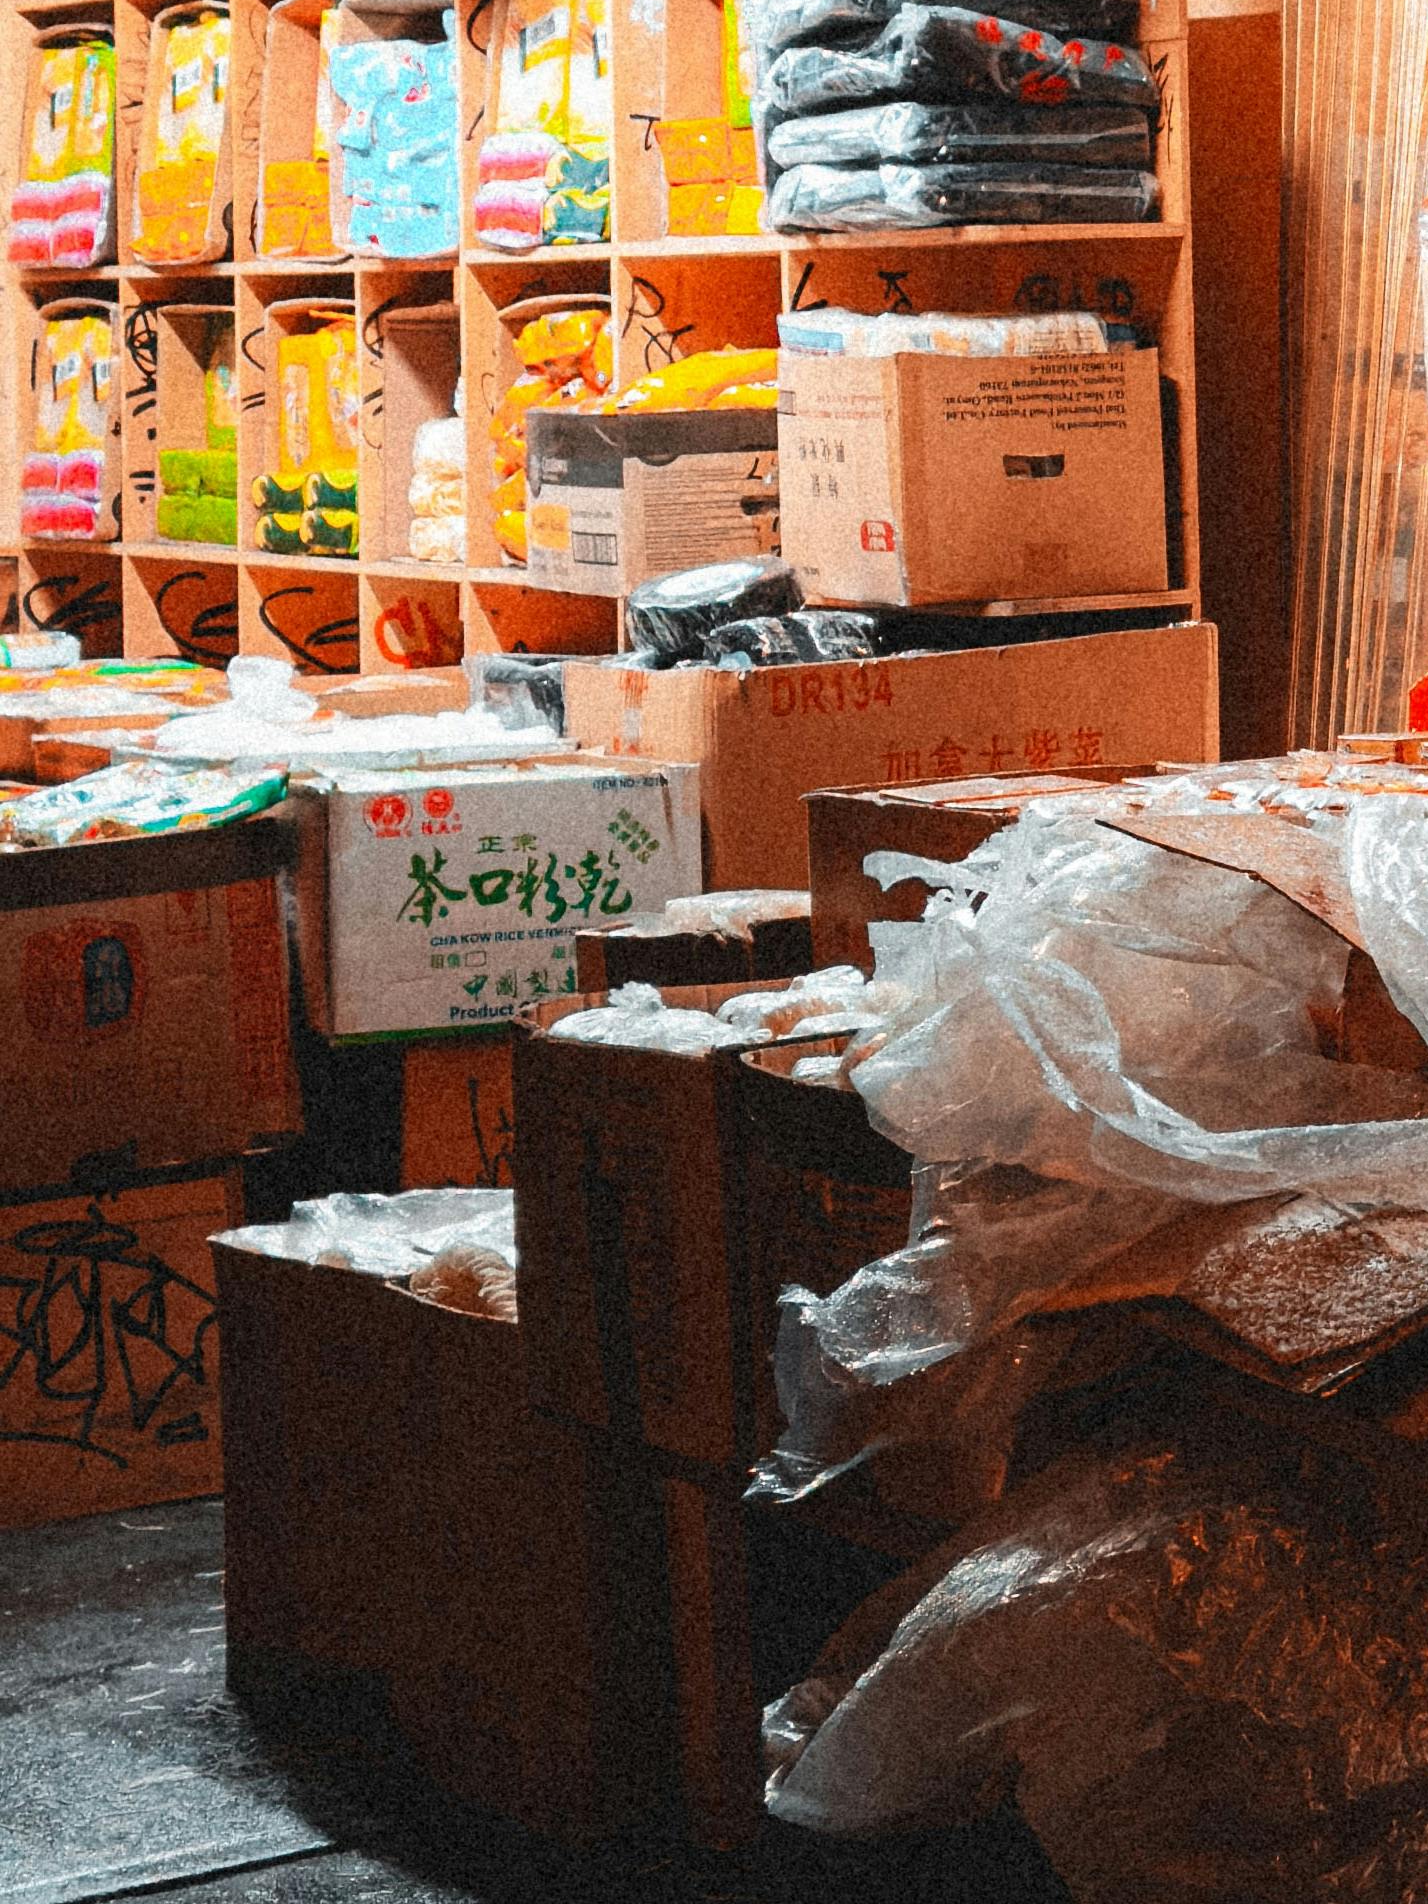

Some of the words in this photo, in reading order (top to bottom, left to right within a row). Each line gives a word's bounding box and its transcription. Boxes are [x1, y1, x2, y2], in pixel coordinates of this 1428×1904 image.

[770, 664, 896, 718] DR134
[396, 844, 634, 928] 茶口粉乾
[430, 936, 458, 948] CHA
[460, 933, 492, 945] KOW
[494, 930, 525, 943] RICE
[449, 1003, 515, 1021] Product
